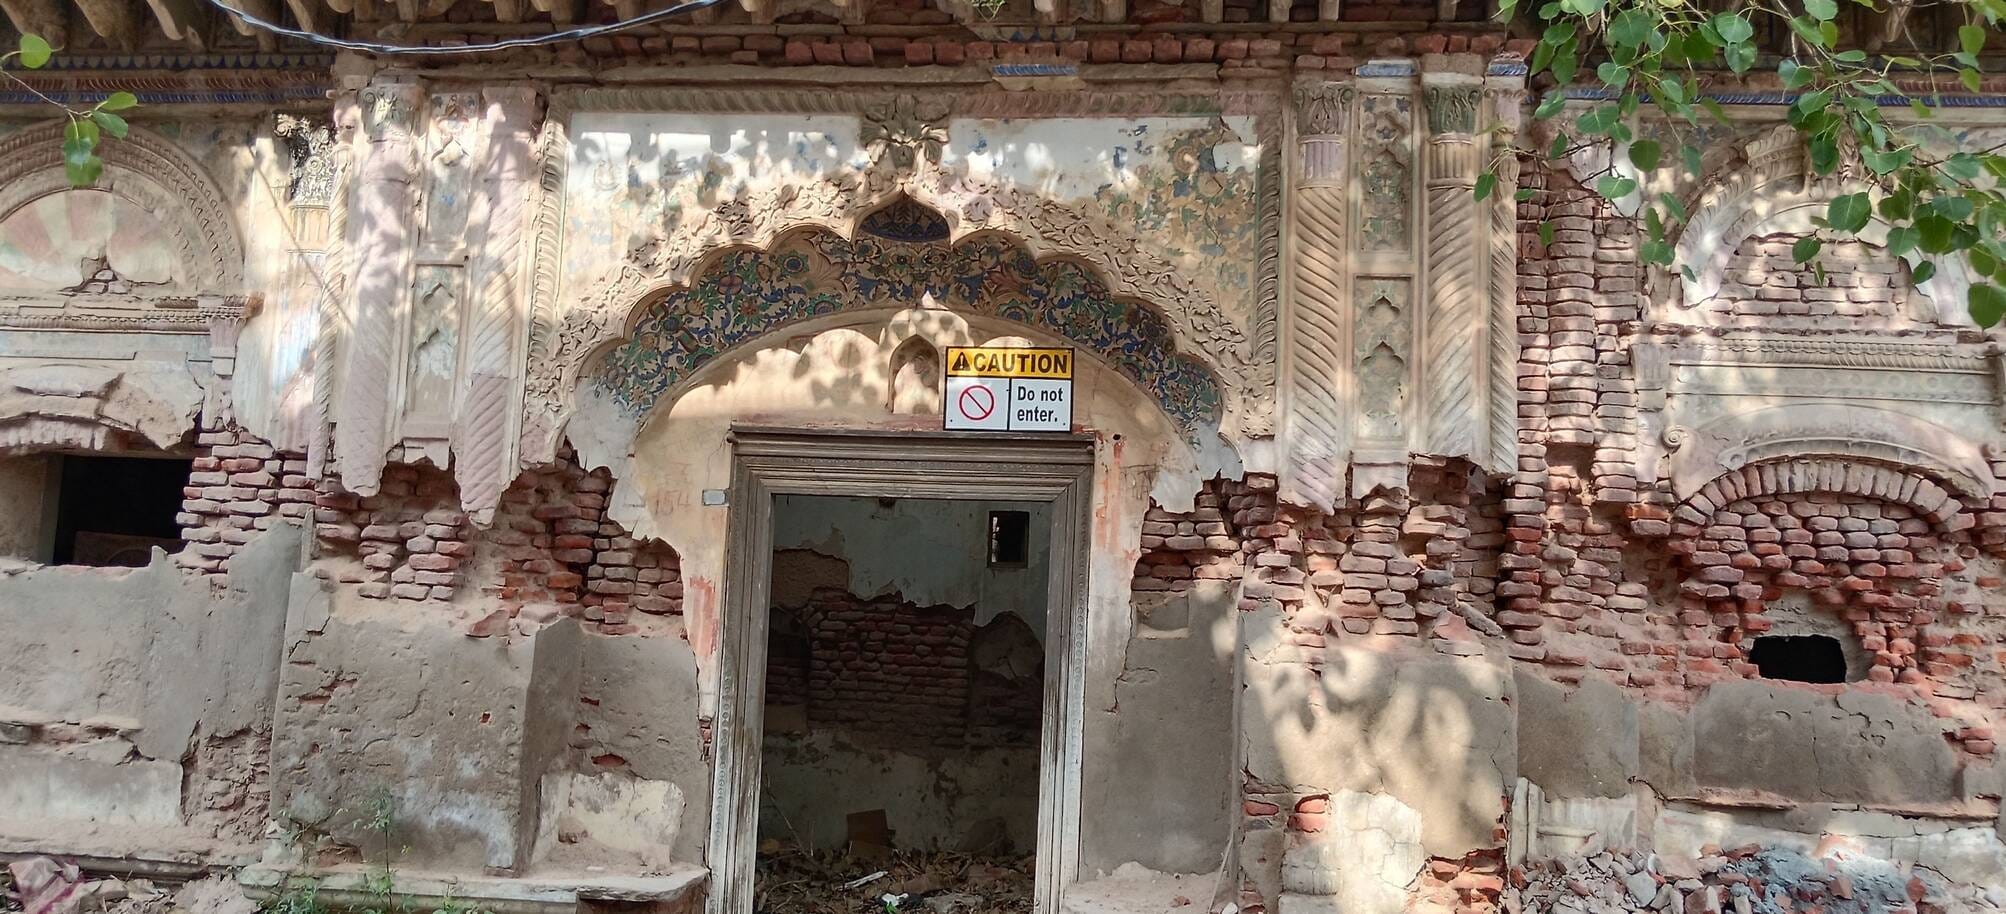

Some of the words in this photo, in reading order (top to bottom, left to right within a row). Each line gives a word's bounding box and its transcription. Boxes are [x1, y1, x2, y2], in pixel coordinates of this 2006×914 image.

[973, 353, 1068, 374] CAUTION
[1017, 386, 1035, 401] Do
[1040, 387, 1063, 402] not
[1017, 406, 1058, 422] enter.
